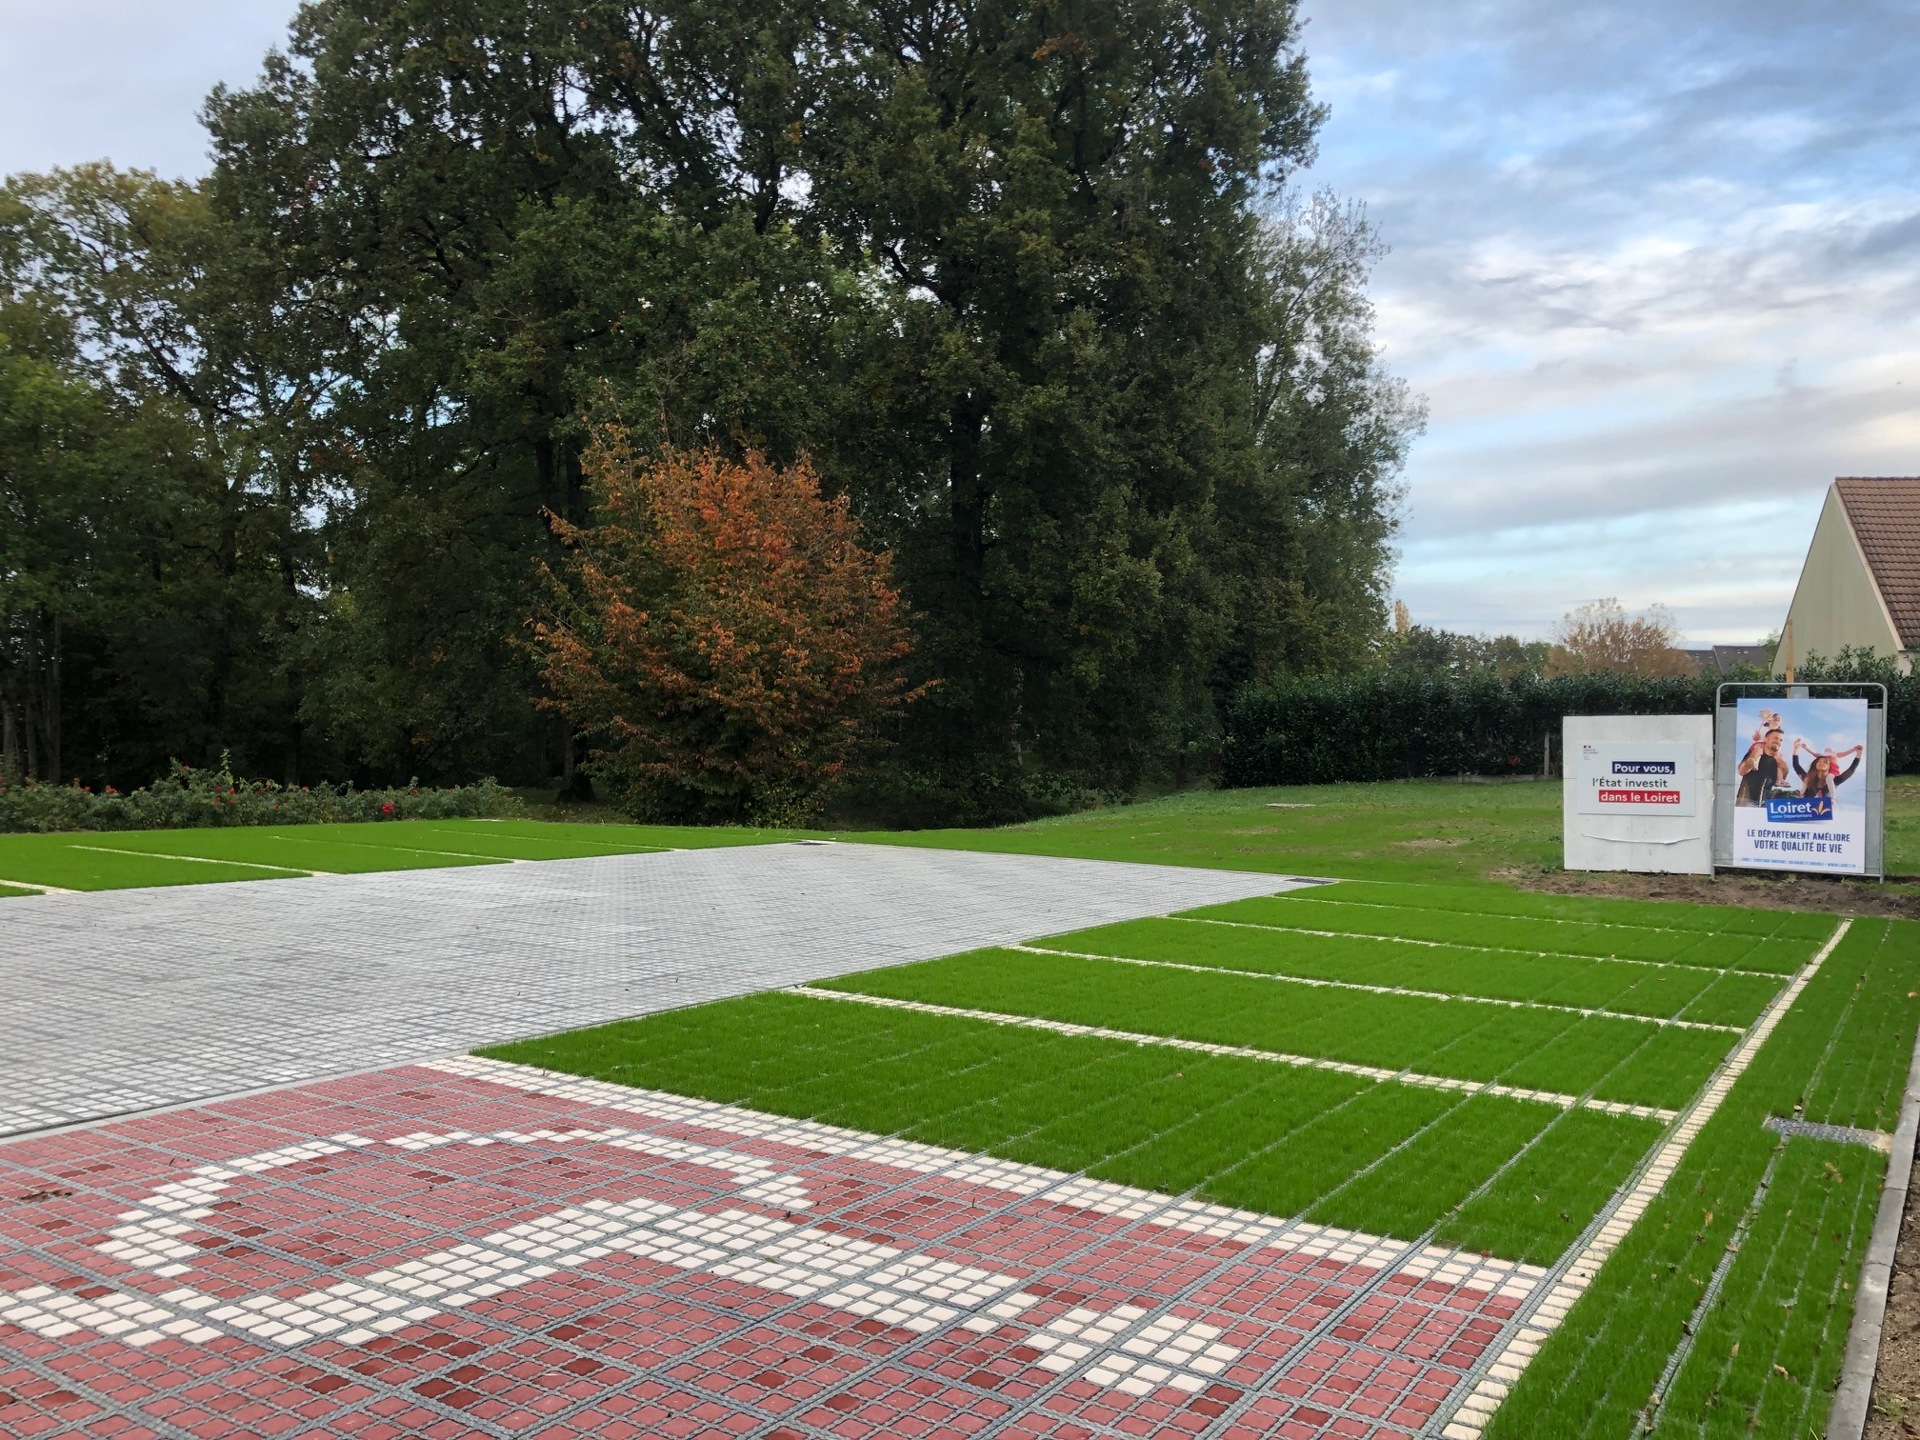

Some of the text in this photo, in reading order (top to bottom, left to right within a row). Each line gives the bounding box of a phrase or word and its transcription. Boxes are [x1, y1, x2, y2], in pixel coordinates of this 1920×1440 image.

[1614, 763, 1674, 774] Pour vous,
[1592, 776, 1668, 788] l'État investit
[1600, 791, 1679, 803] dans le Loiret
[1769, 801, 1812, 814] Loiret
[1747, 829, 1851, 842] LE DÉPARTEMENT AMÉLIORE
[1754, 839, 1843, 854] VOTRE QUALITÉ DE VIE
